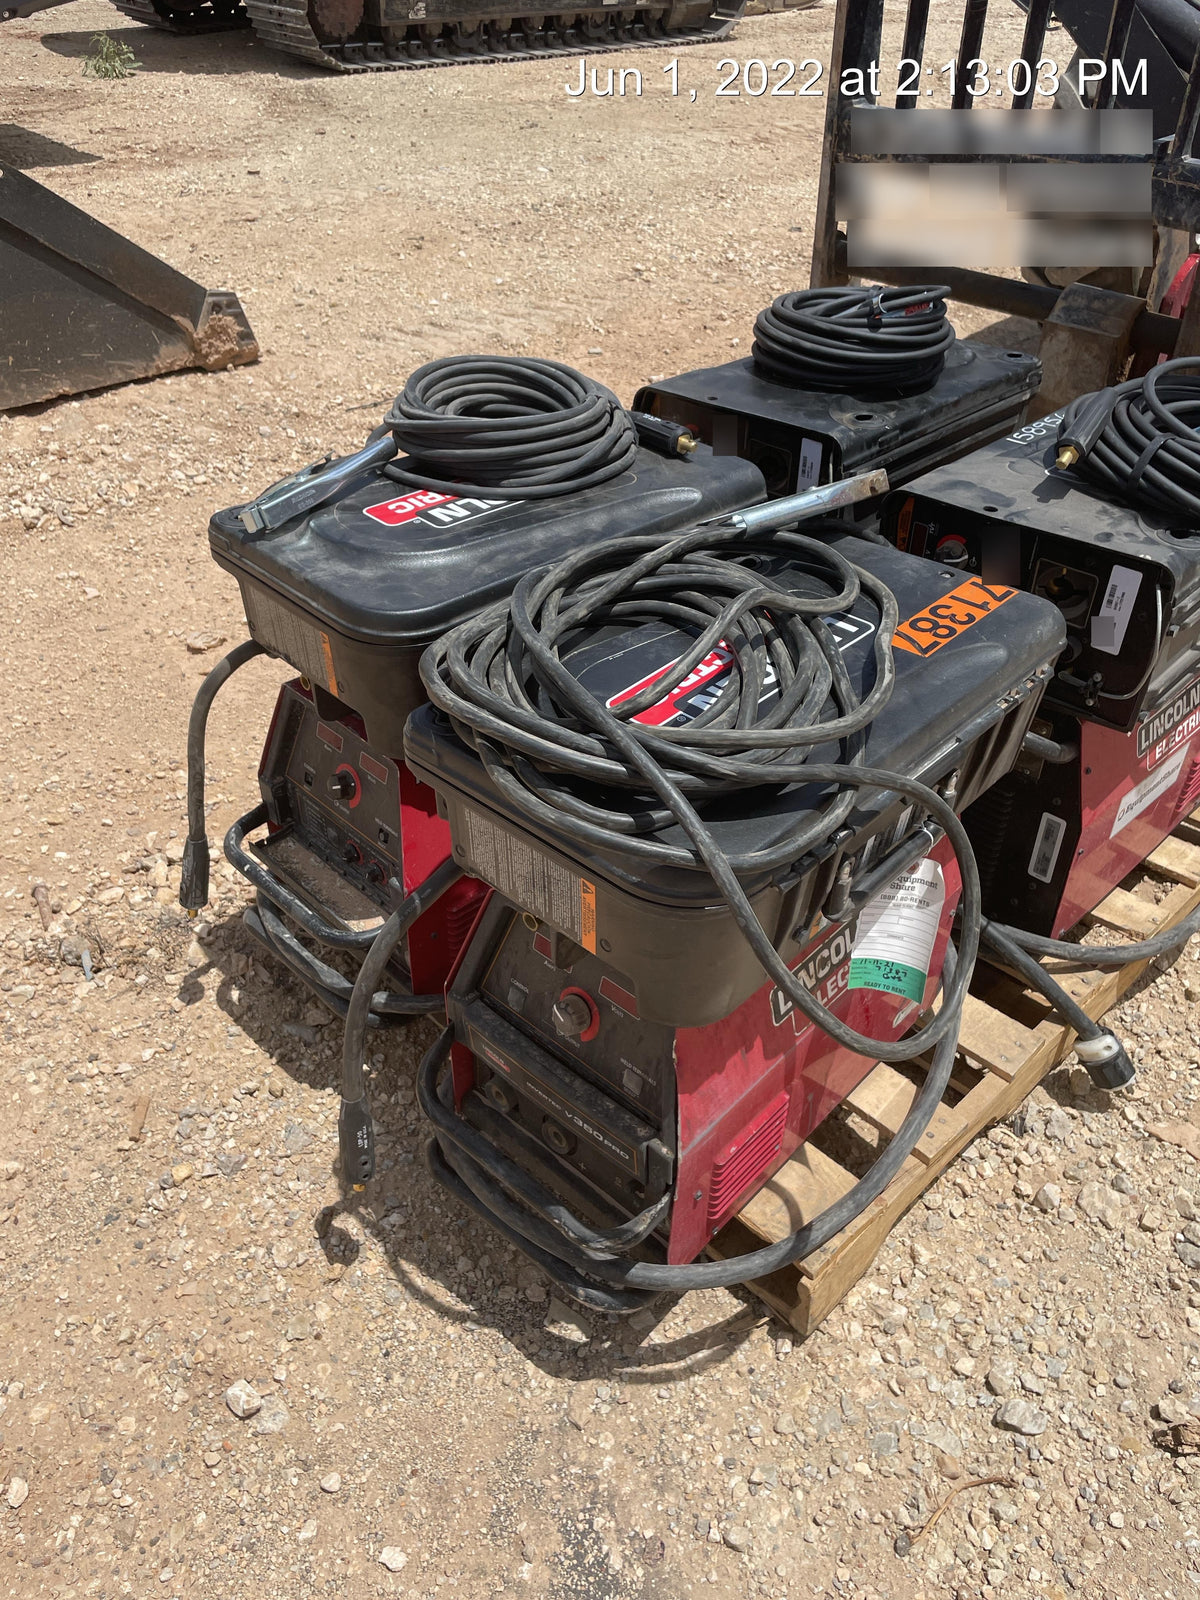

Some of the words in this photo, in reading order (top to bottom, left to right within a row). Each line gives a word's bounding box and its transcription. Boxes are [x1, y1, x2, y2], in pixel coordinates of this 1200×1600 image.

[895, 580, 1014, 656] 71387
[1141, 688, 1200, 751] LINCOLN
[890, 881, 916, 892] Share
[897, 875, 938, 890] quipment
[892, 986, 906, 995] RENT
